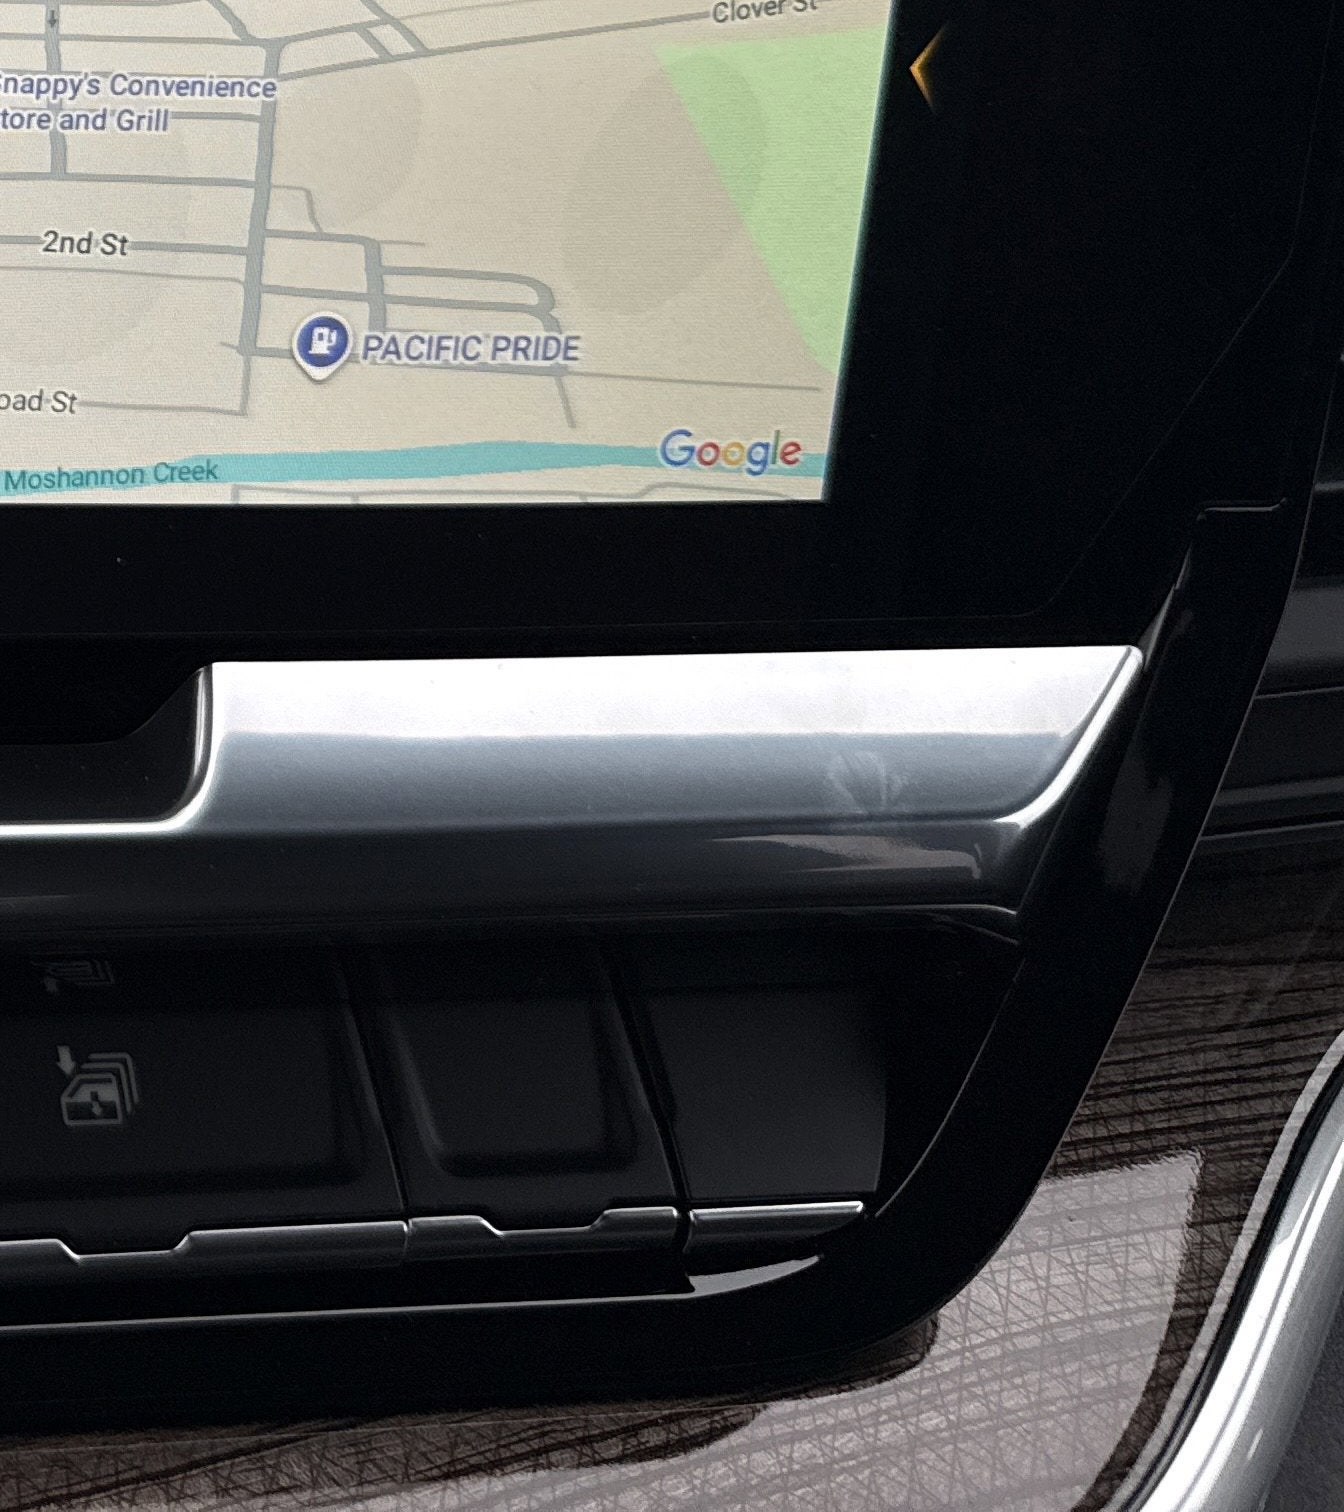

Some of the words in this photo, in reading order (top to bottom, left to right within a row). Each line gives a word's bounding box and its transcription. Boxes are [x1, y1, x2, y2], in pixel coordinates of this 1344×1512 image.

[109, 73, 277, 98] Convenience
[59, 109, 106, 131] and
[115, 109, 168, 132] Grill
[43, 231, 91, 256] 2nd
[100, 233, 128, 257] St
[362, 335, 482, 362] PACIFIC
[492, 337, 580, 362] PRIDE
[51, 391, 77, 414] St
[660, 429, 801, 475] Google
[4, 462, 144, 491] Moshannon
[154, 460, 218, 483] Creek
